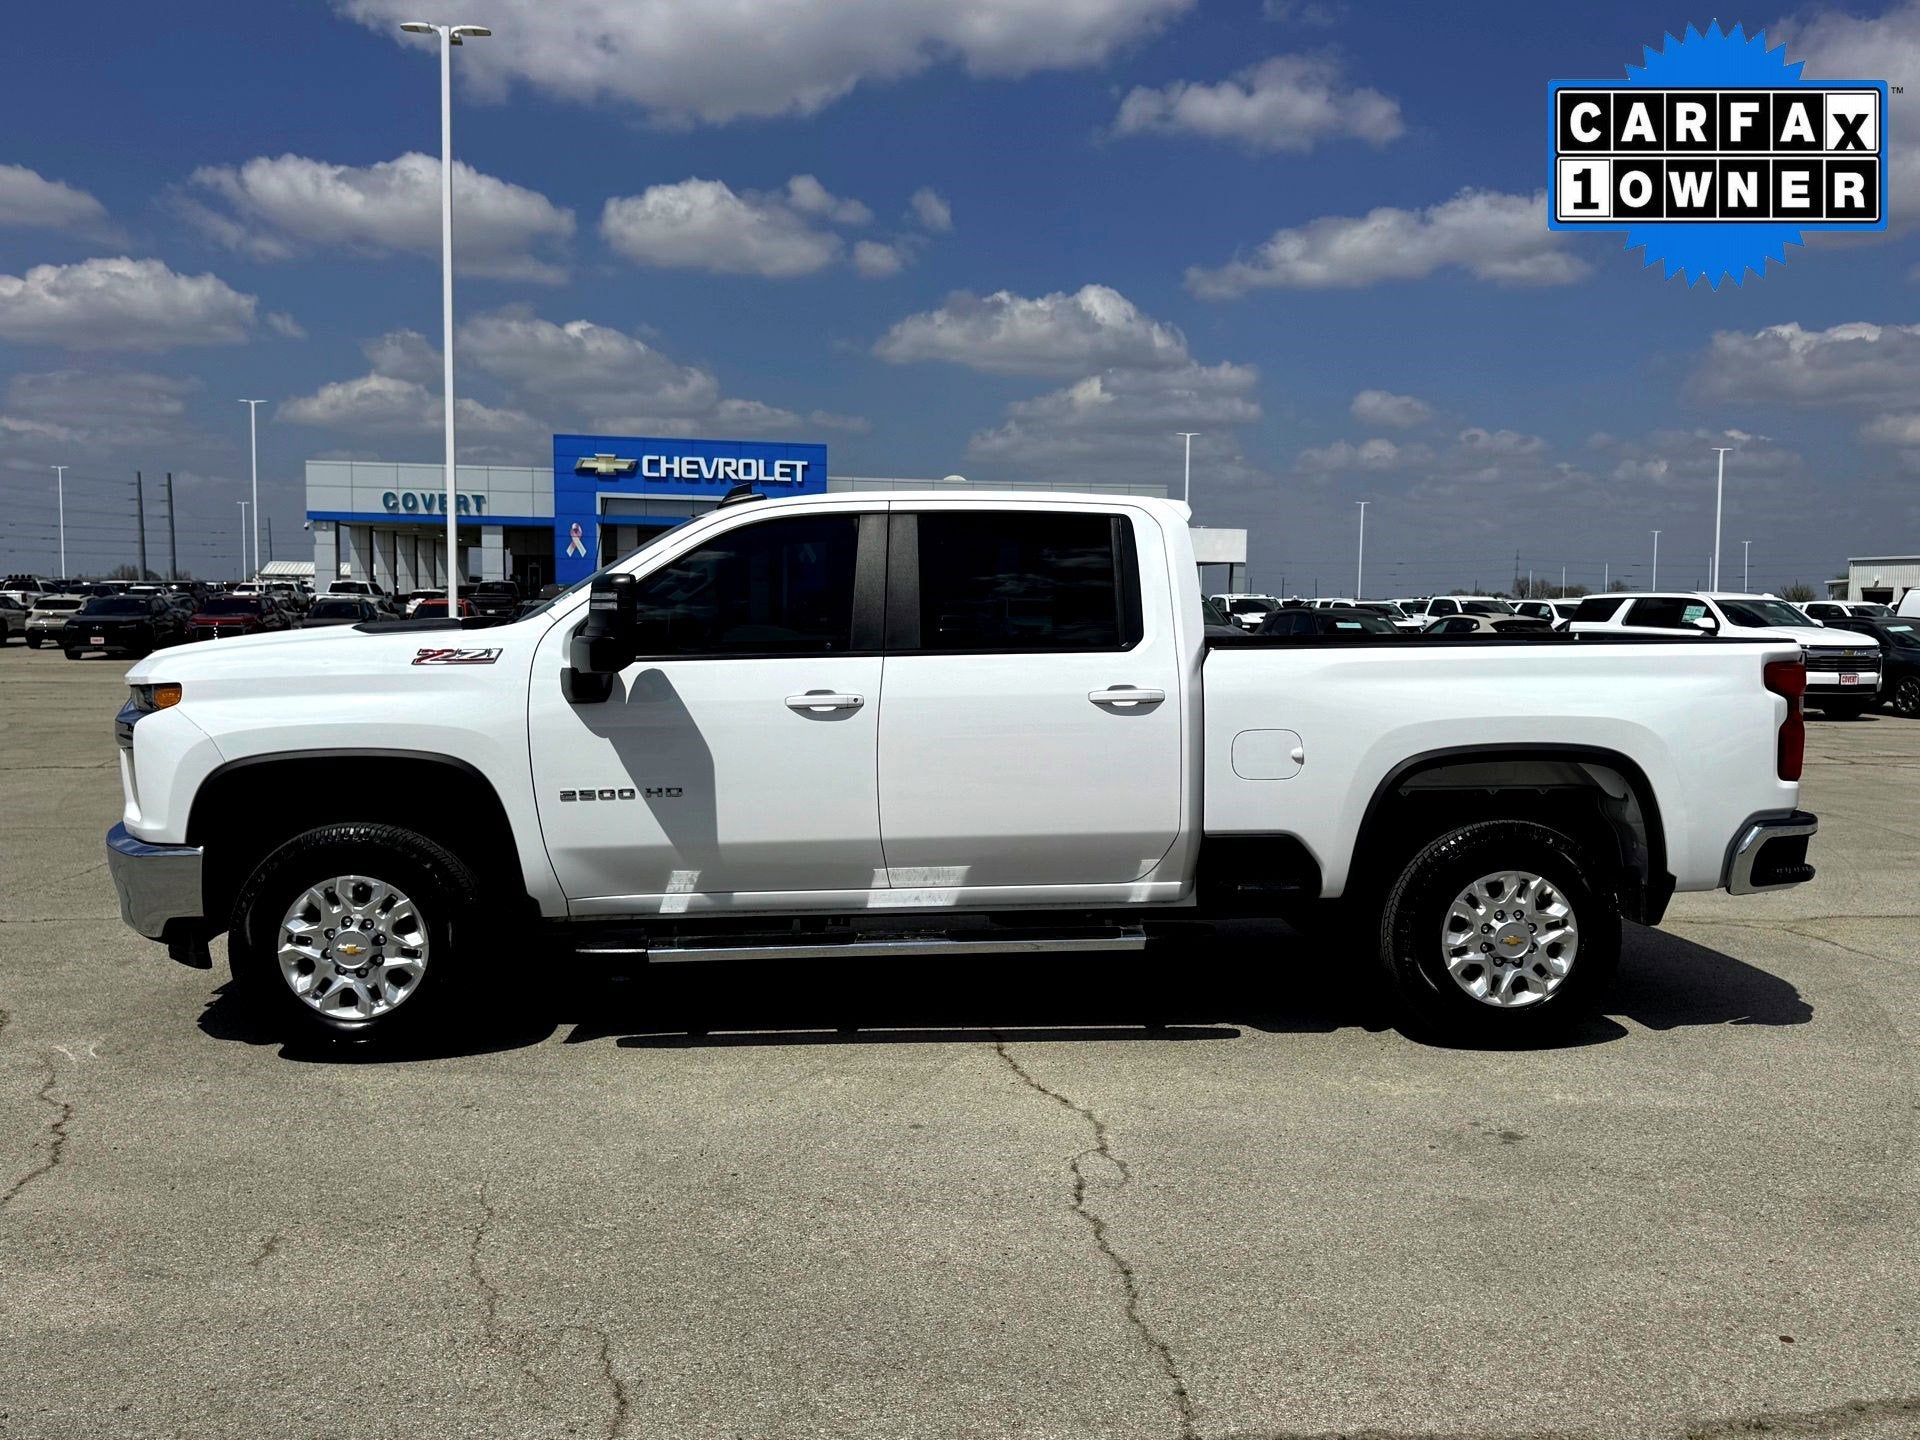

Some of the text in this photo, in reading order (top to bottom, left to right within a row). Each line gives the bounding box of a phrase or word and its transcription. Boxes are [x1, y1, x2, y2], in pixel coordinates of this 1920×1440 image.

[642, 455, 808, 482] CHEVROLET
[382, 491, 486, 513] COVERT
[560, 787, 682, 802] 2500 HD
